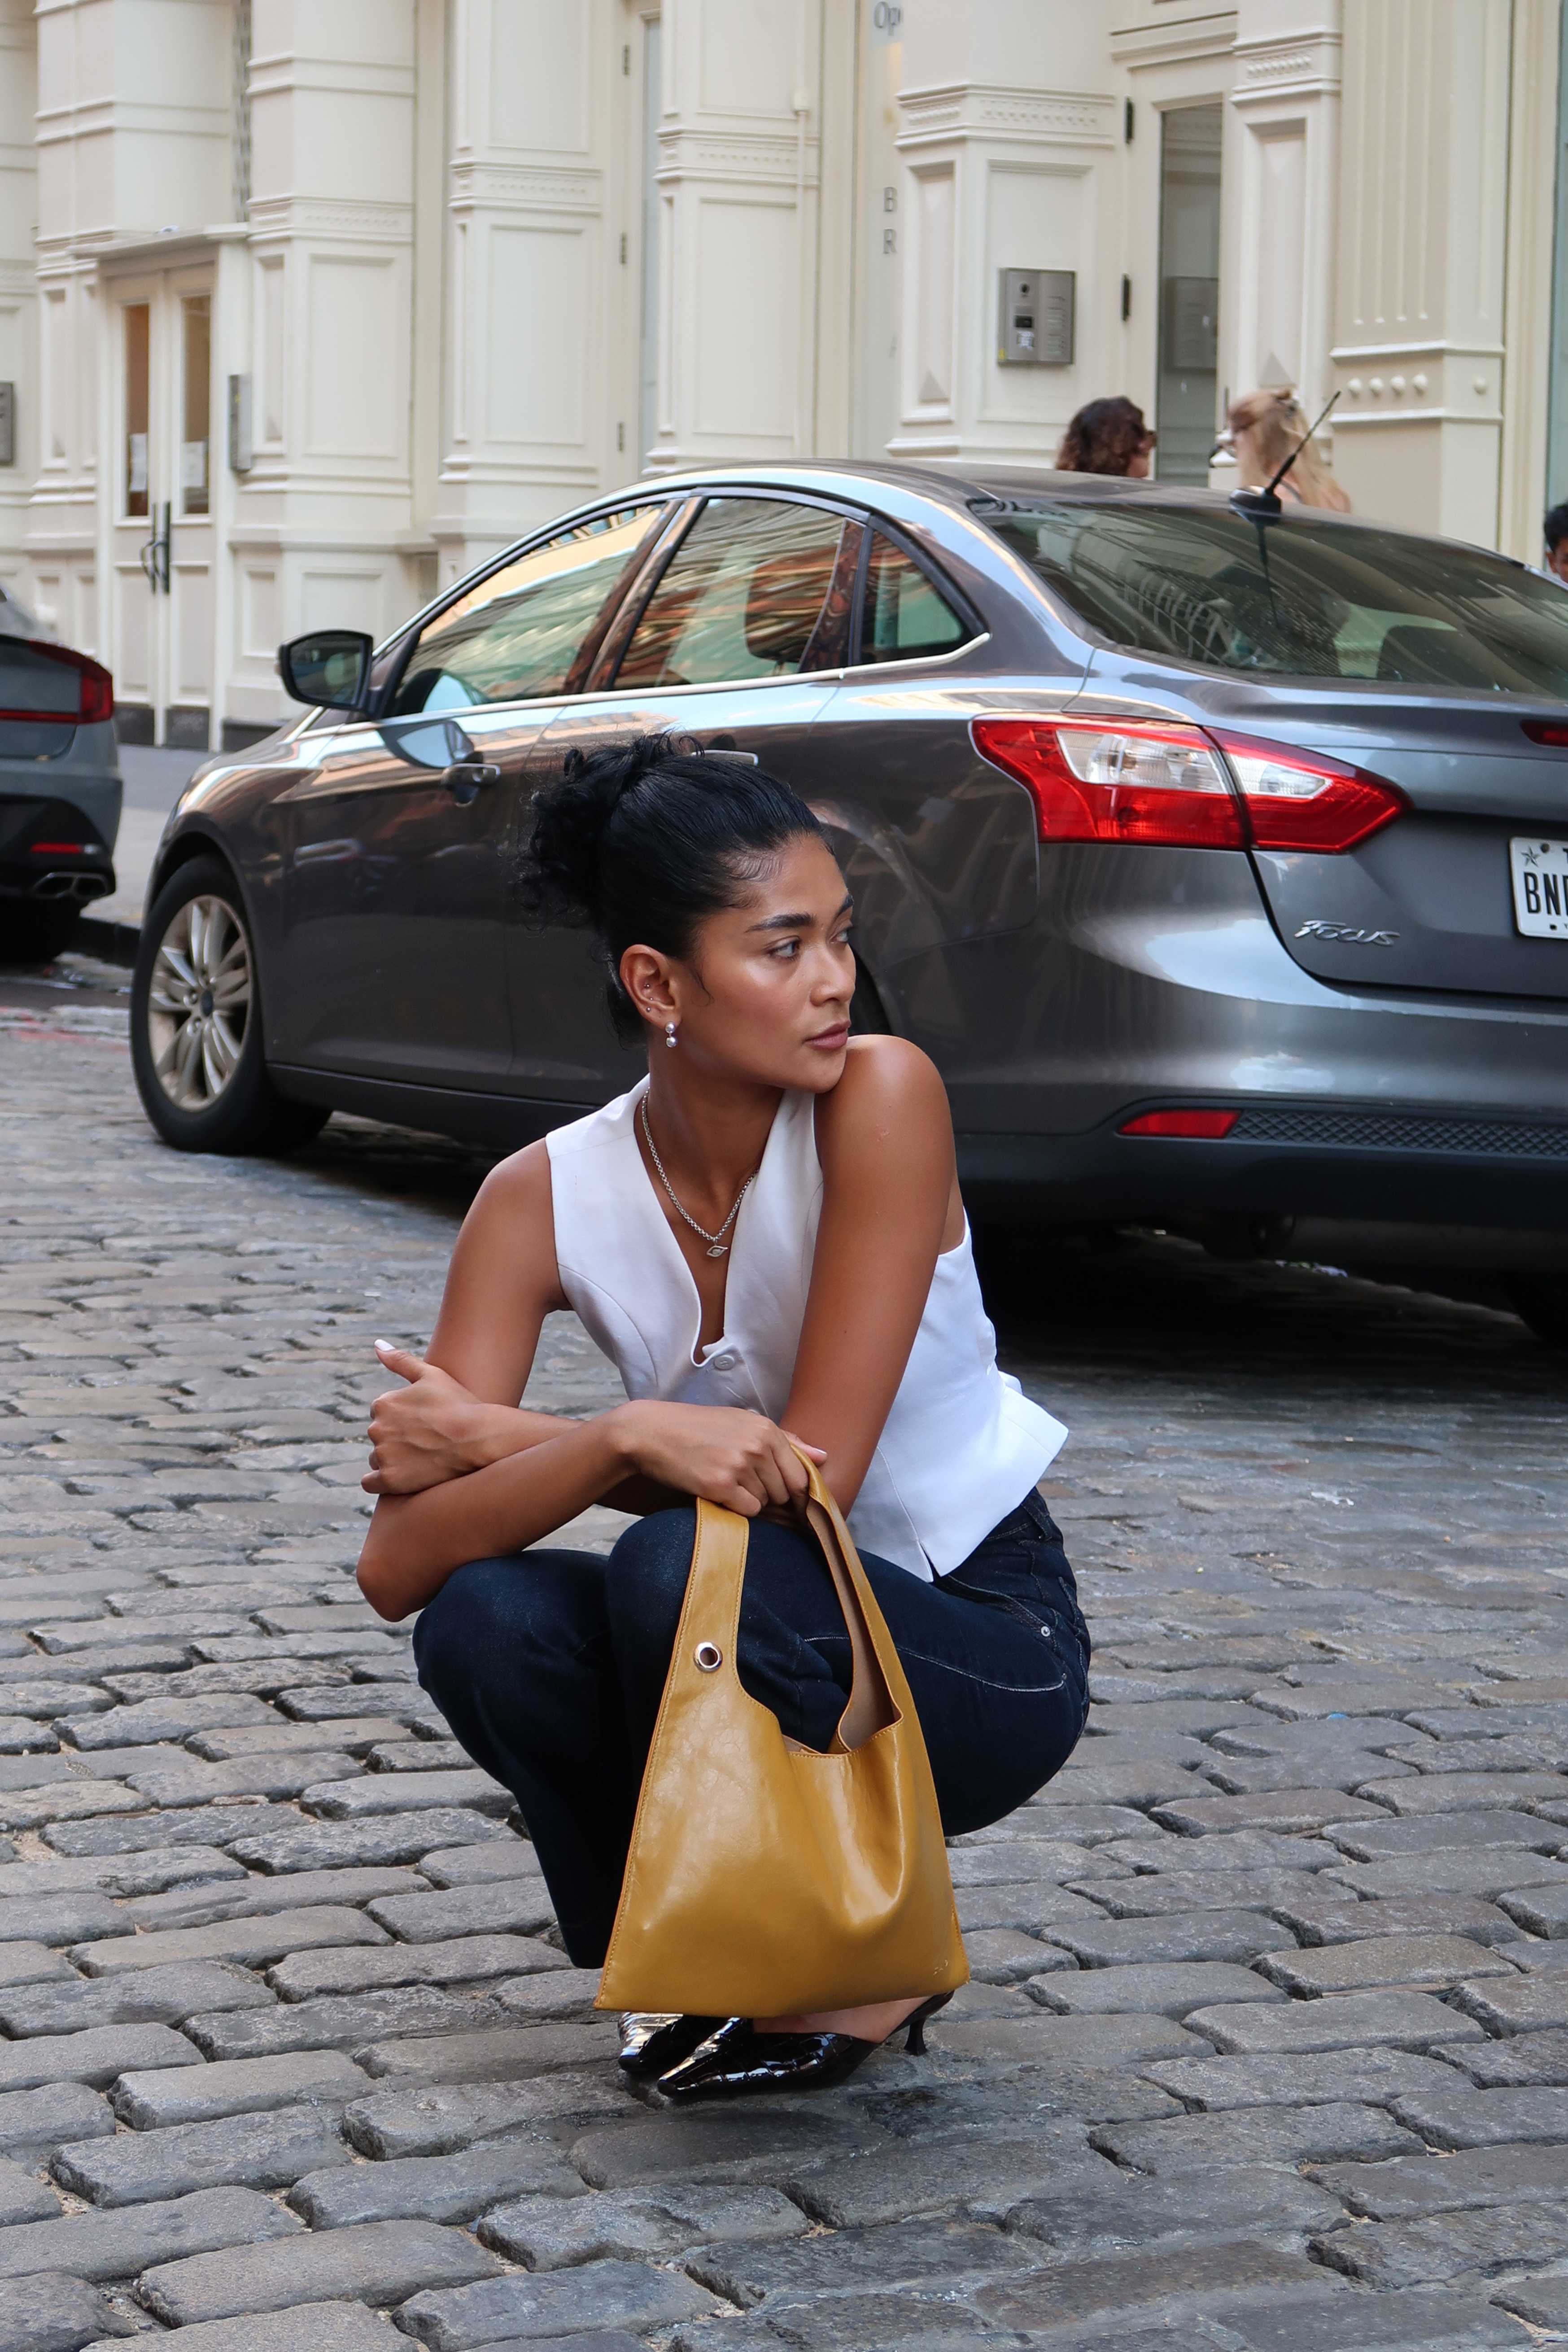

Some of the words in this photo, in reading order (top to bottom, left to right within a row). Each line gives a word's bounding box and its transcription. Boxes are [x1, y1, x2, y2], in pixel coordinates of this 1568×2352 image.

[883, 187, 897, 212] B
[883, 229, 896, 254] R
[1524, 871, 1568, 916] BN
